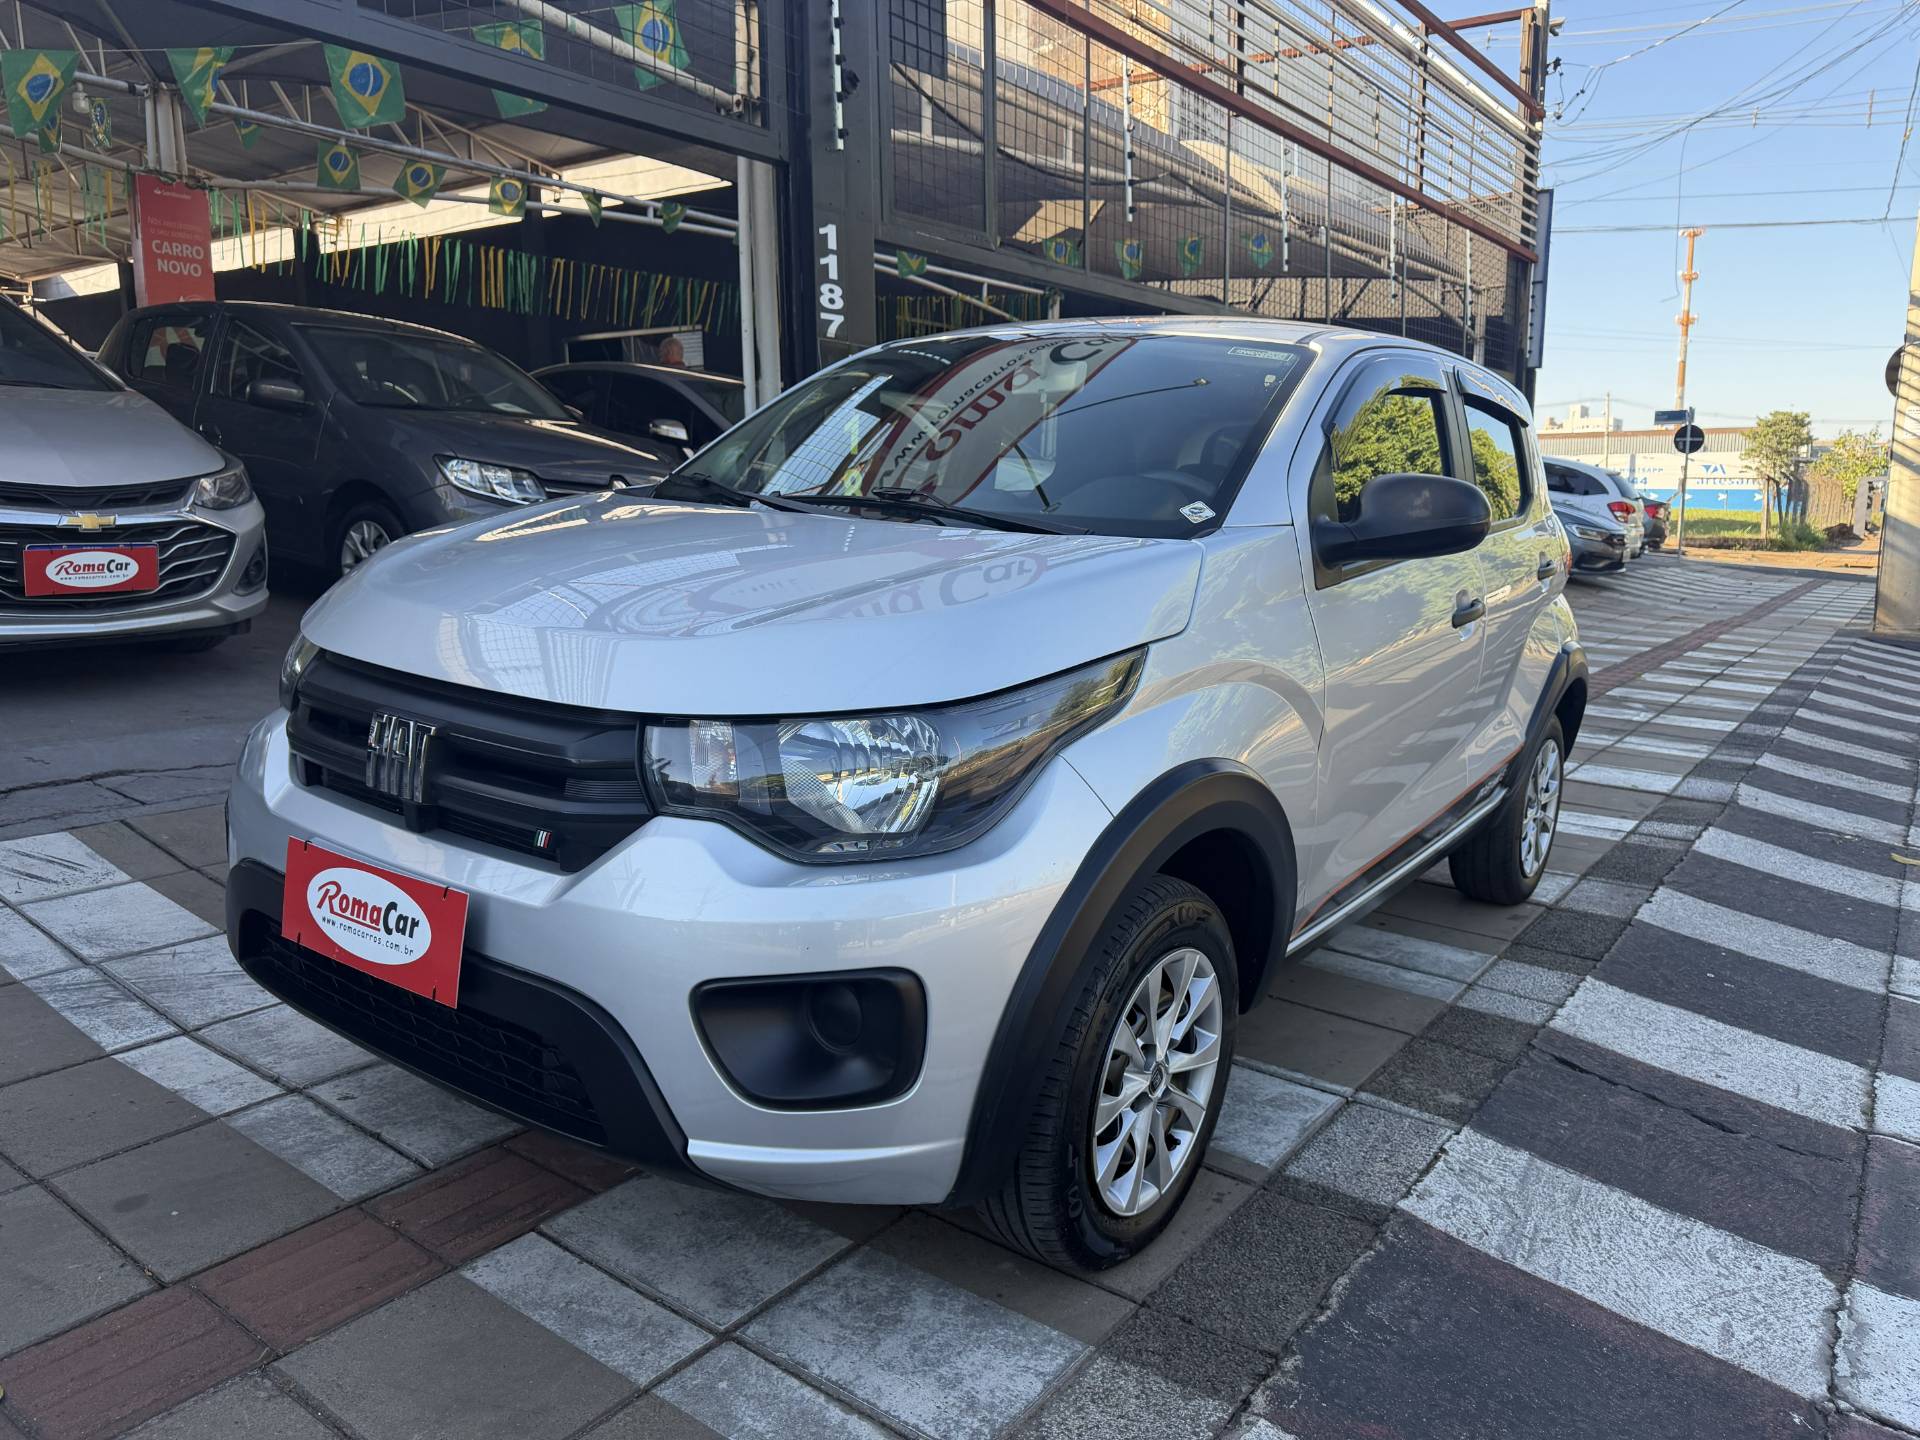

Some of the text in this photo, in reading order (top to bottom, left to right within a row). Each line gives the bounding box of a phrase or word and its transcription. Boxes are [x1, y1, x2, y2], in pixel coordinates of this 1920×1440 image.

[151, 239, 205, 260] CARRO
[157, 258, 202, 277] NOVO
[818, 224, 845, 338] 1187
[54, 559, 131, 576] RomaCar
[365, 711, 437, 803] FIAT
[317, 881, 420, 939] RomaCar
[322, 915, 414, 956] www.romacarros.com.br
